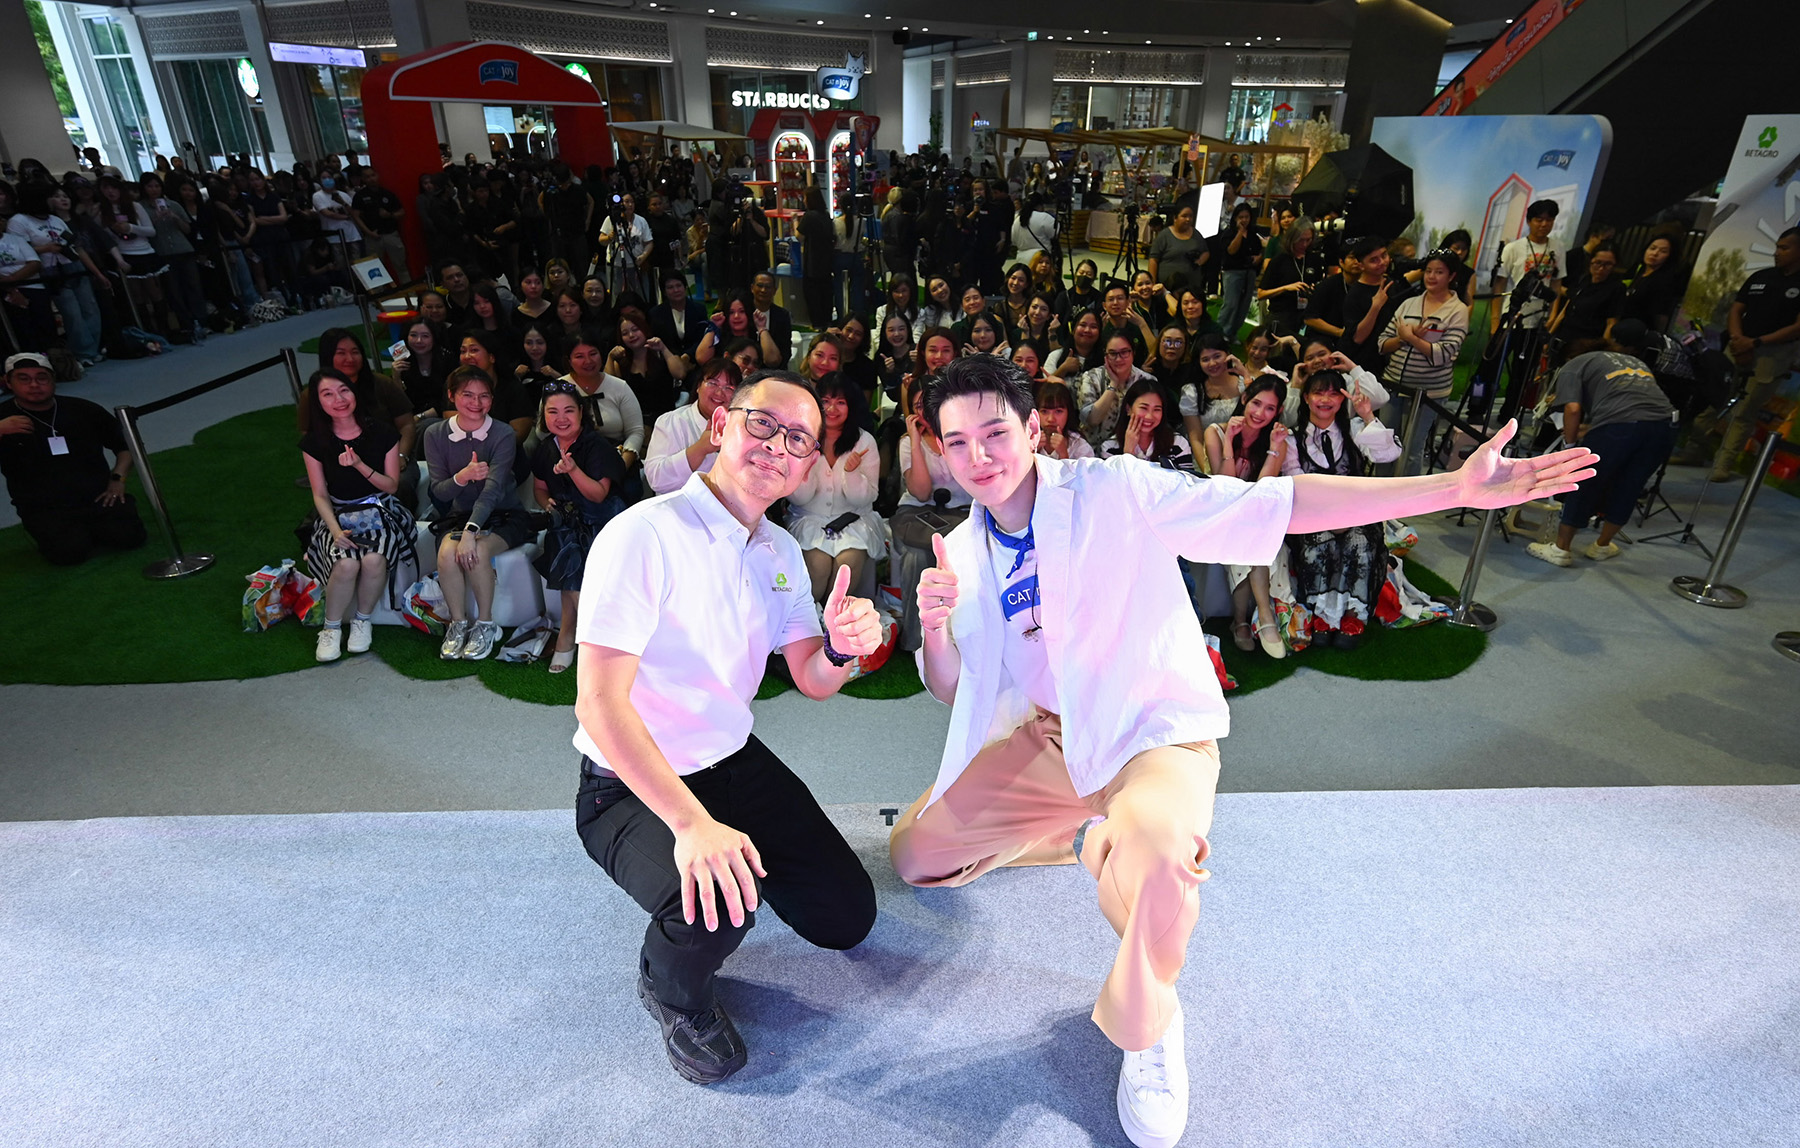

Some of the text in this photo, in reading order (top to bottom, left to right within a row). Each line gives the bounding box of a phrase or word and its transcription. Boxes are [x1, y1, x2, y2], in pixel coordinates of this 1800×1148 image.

[483, 66, 495, 75] CAT
[732, 90, 831, 109] STARBUCKS
[1745, 149, 1779, 158] BETAGRO
[1007, 588, 1031, 606] CAT
